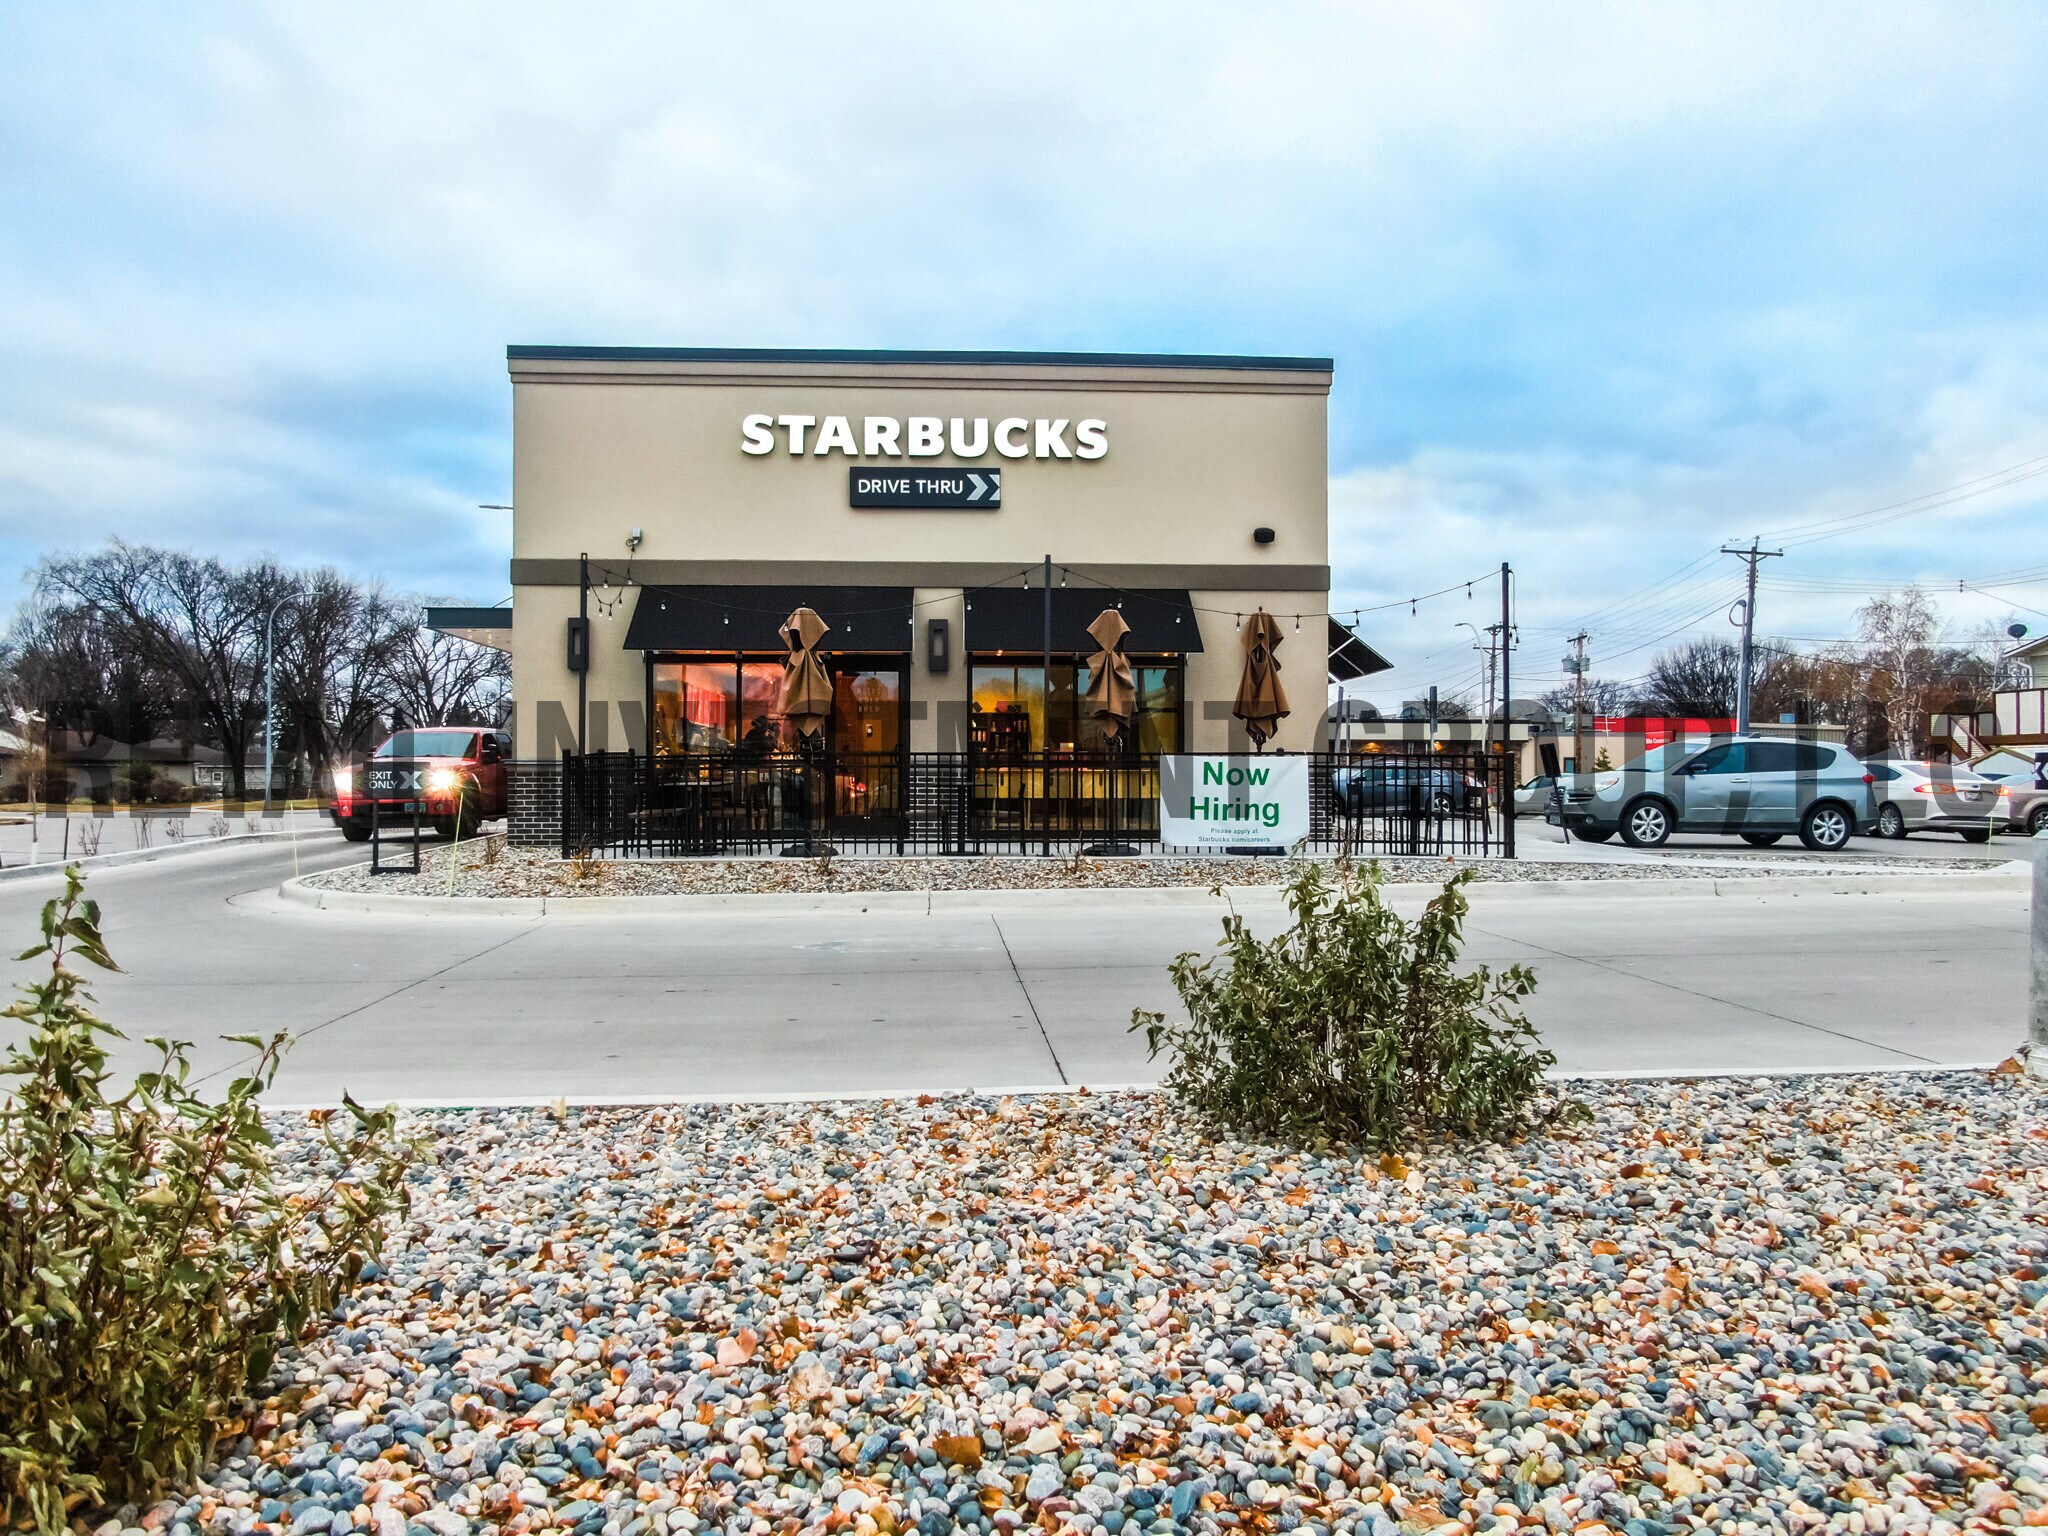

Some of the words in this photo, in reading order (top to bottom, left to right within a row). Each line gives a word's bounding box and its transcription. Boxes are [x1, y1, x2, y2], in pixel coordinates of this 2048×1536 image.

[740, 414, 1109, 460] STARBUCKS
[858, 479, 911, 495] DRIVE
[916, 479, 964, 495] THRU
[369, 771, 392, 780] EXIT
[1203, 761, 1270, 786] Now
[369, 780, 398, 789] ONLY
[1190, 797, 1279, 827] Hiring
[1197, 835, 1271, 843] Starbuckscom/careers
